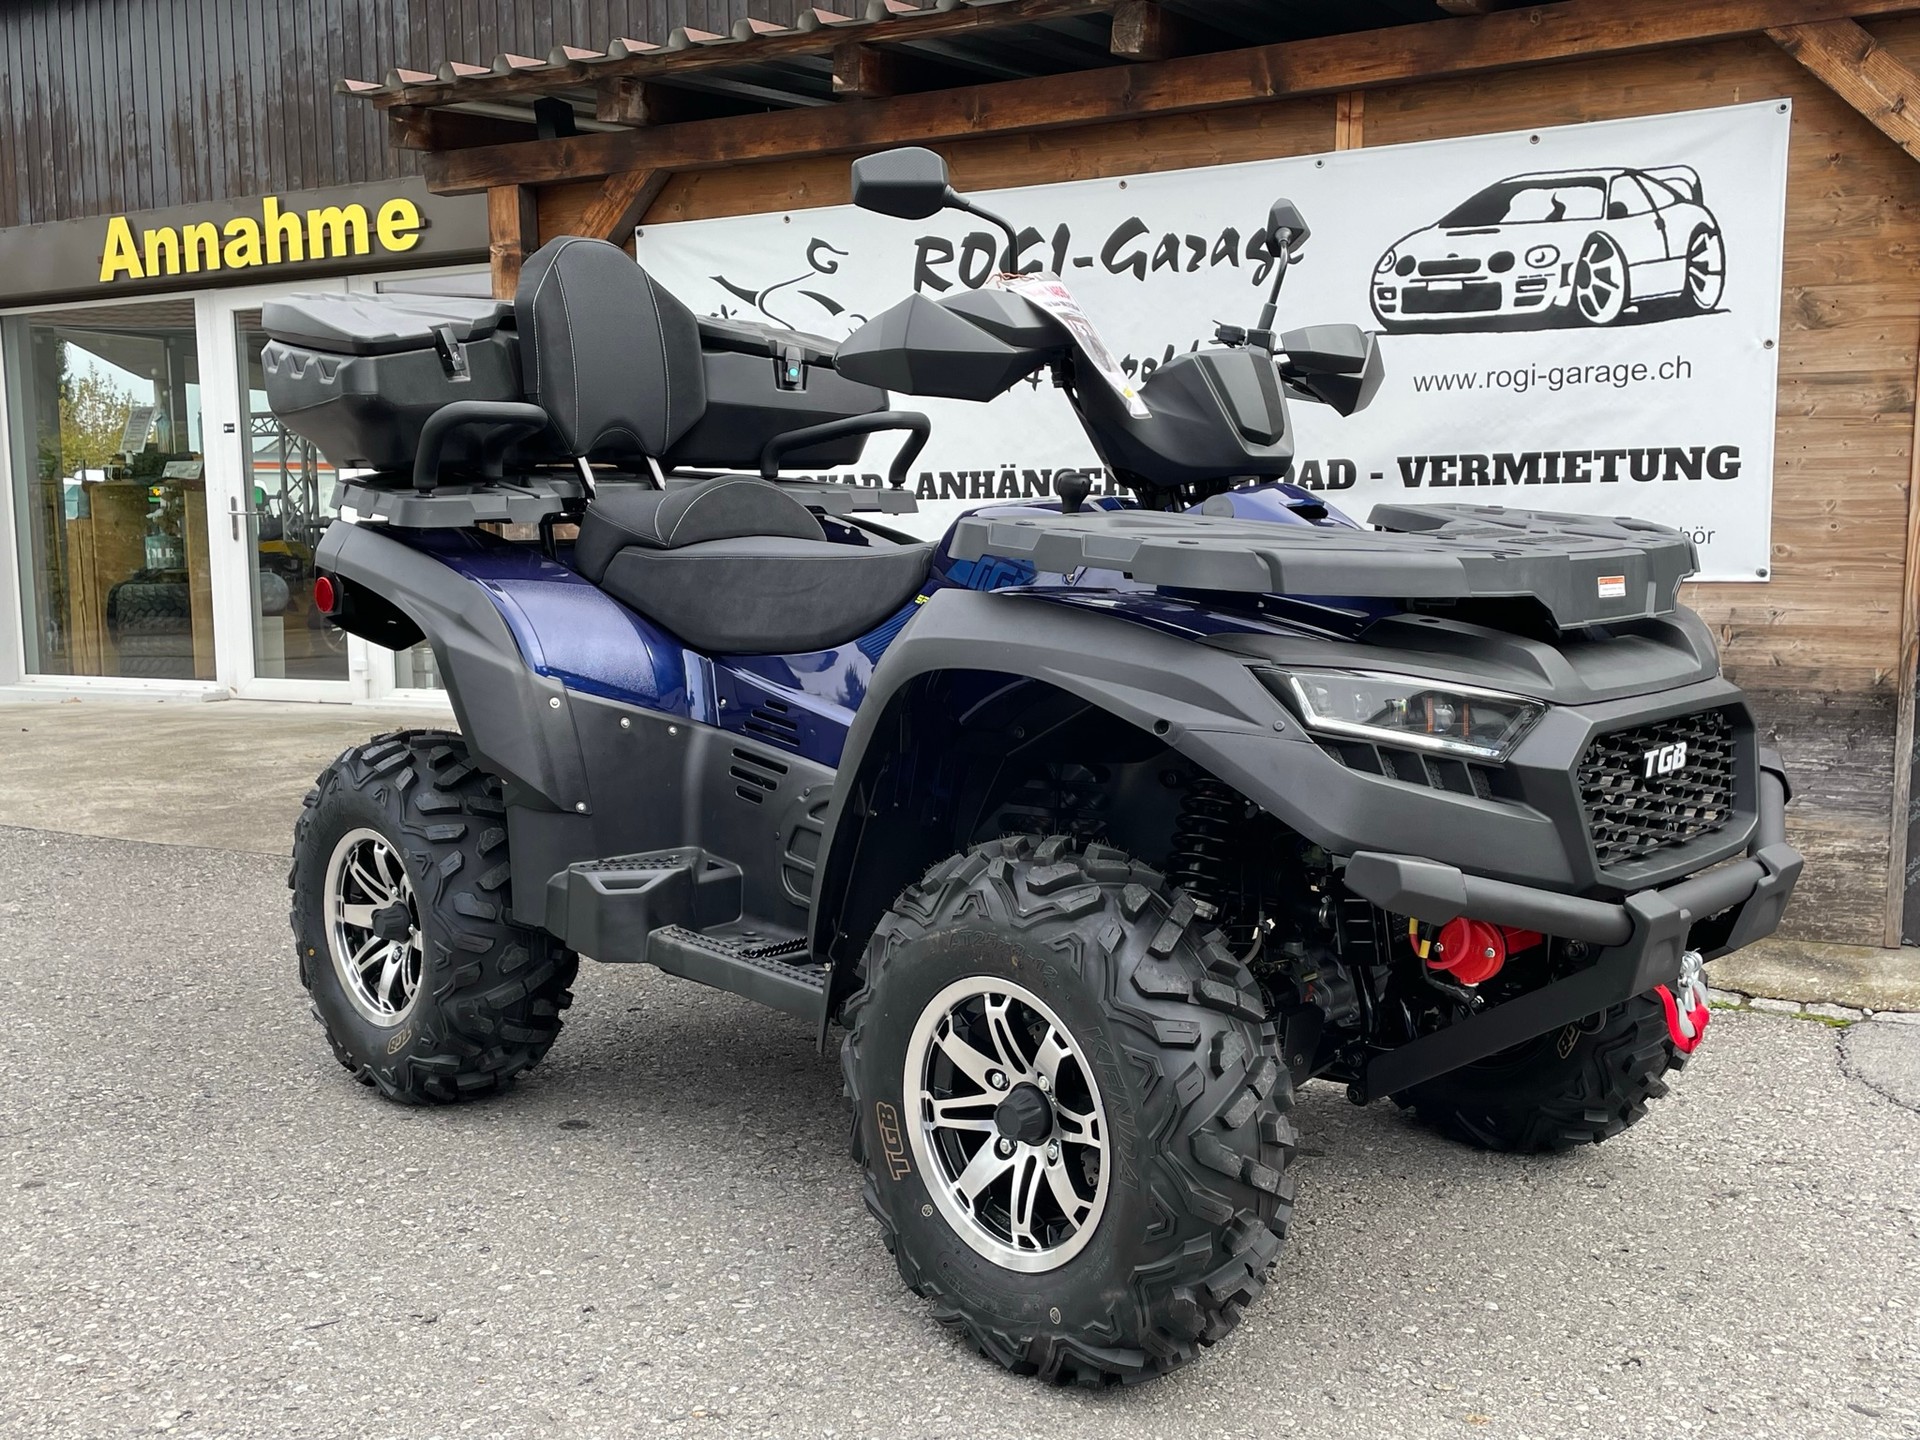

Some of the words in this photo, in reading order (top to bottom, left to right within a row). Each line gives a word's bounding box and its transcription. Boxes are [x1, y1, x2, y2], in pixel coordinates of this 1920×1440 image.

[99, 196, 420, 282] Annahme
[1413, 355, 1692, 393] www.rogi-garage.ch
[1397, 445, 1742, 488] VERMIETUNG
[1643, 741, 1687, 779] TGB
[876, 1101, 911, 1181] TGB
